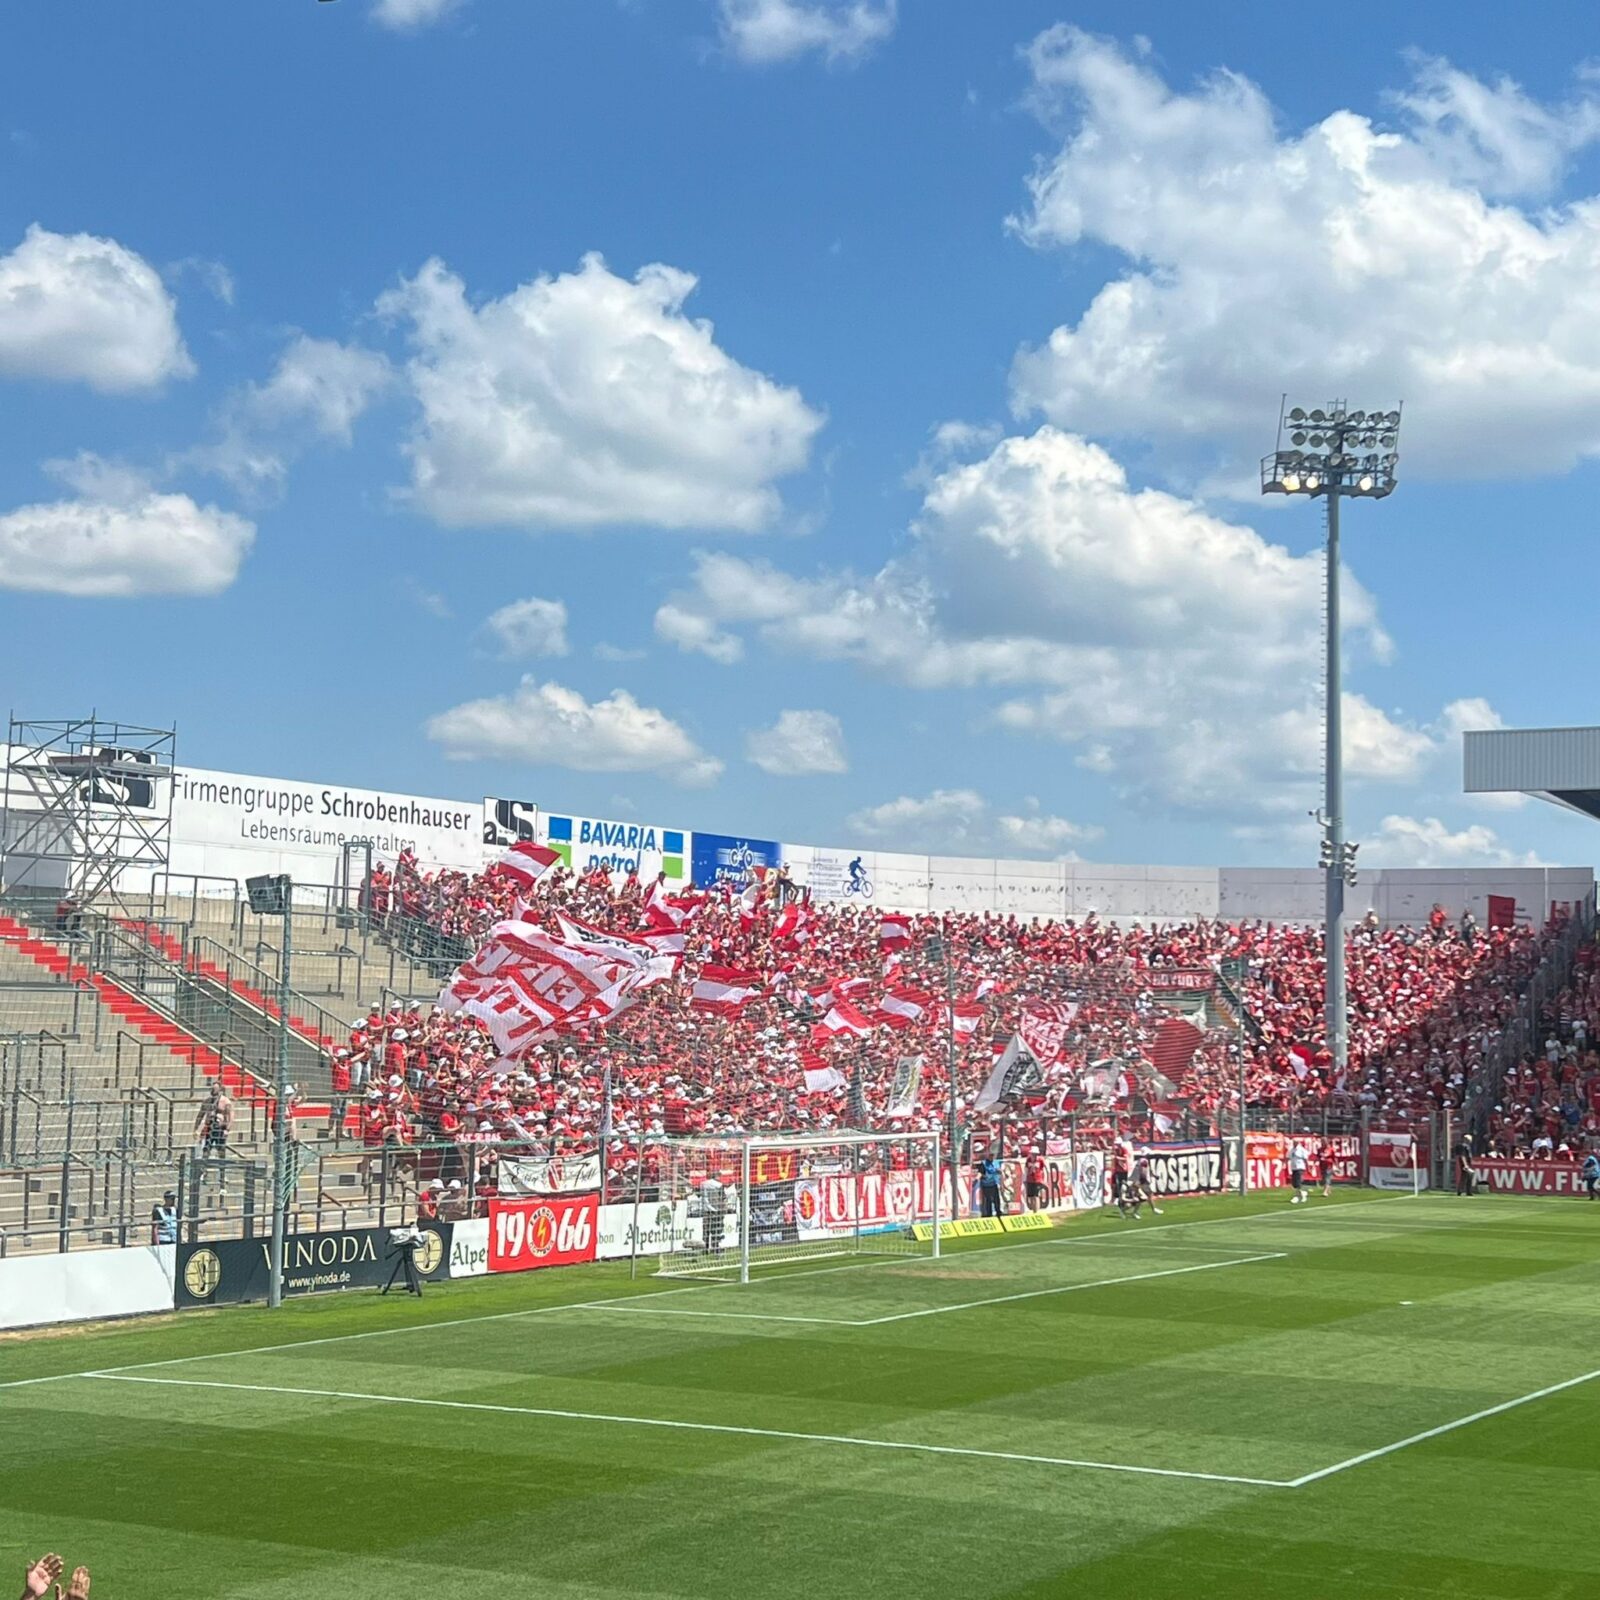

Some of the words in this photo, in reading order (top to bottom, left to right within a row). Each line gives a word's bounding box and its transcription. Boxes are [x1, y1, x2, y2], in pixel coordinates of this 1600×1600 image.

[172, 773, 314, 817] Firmengruppe
[320, 790, 471, 831] Schrobenhauser
[241, 818, 346, 847] Lebensräume
[580, 820, 657, 851] BAVARIA
[623, 1222, 695, 1251] Alpenbauer
